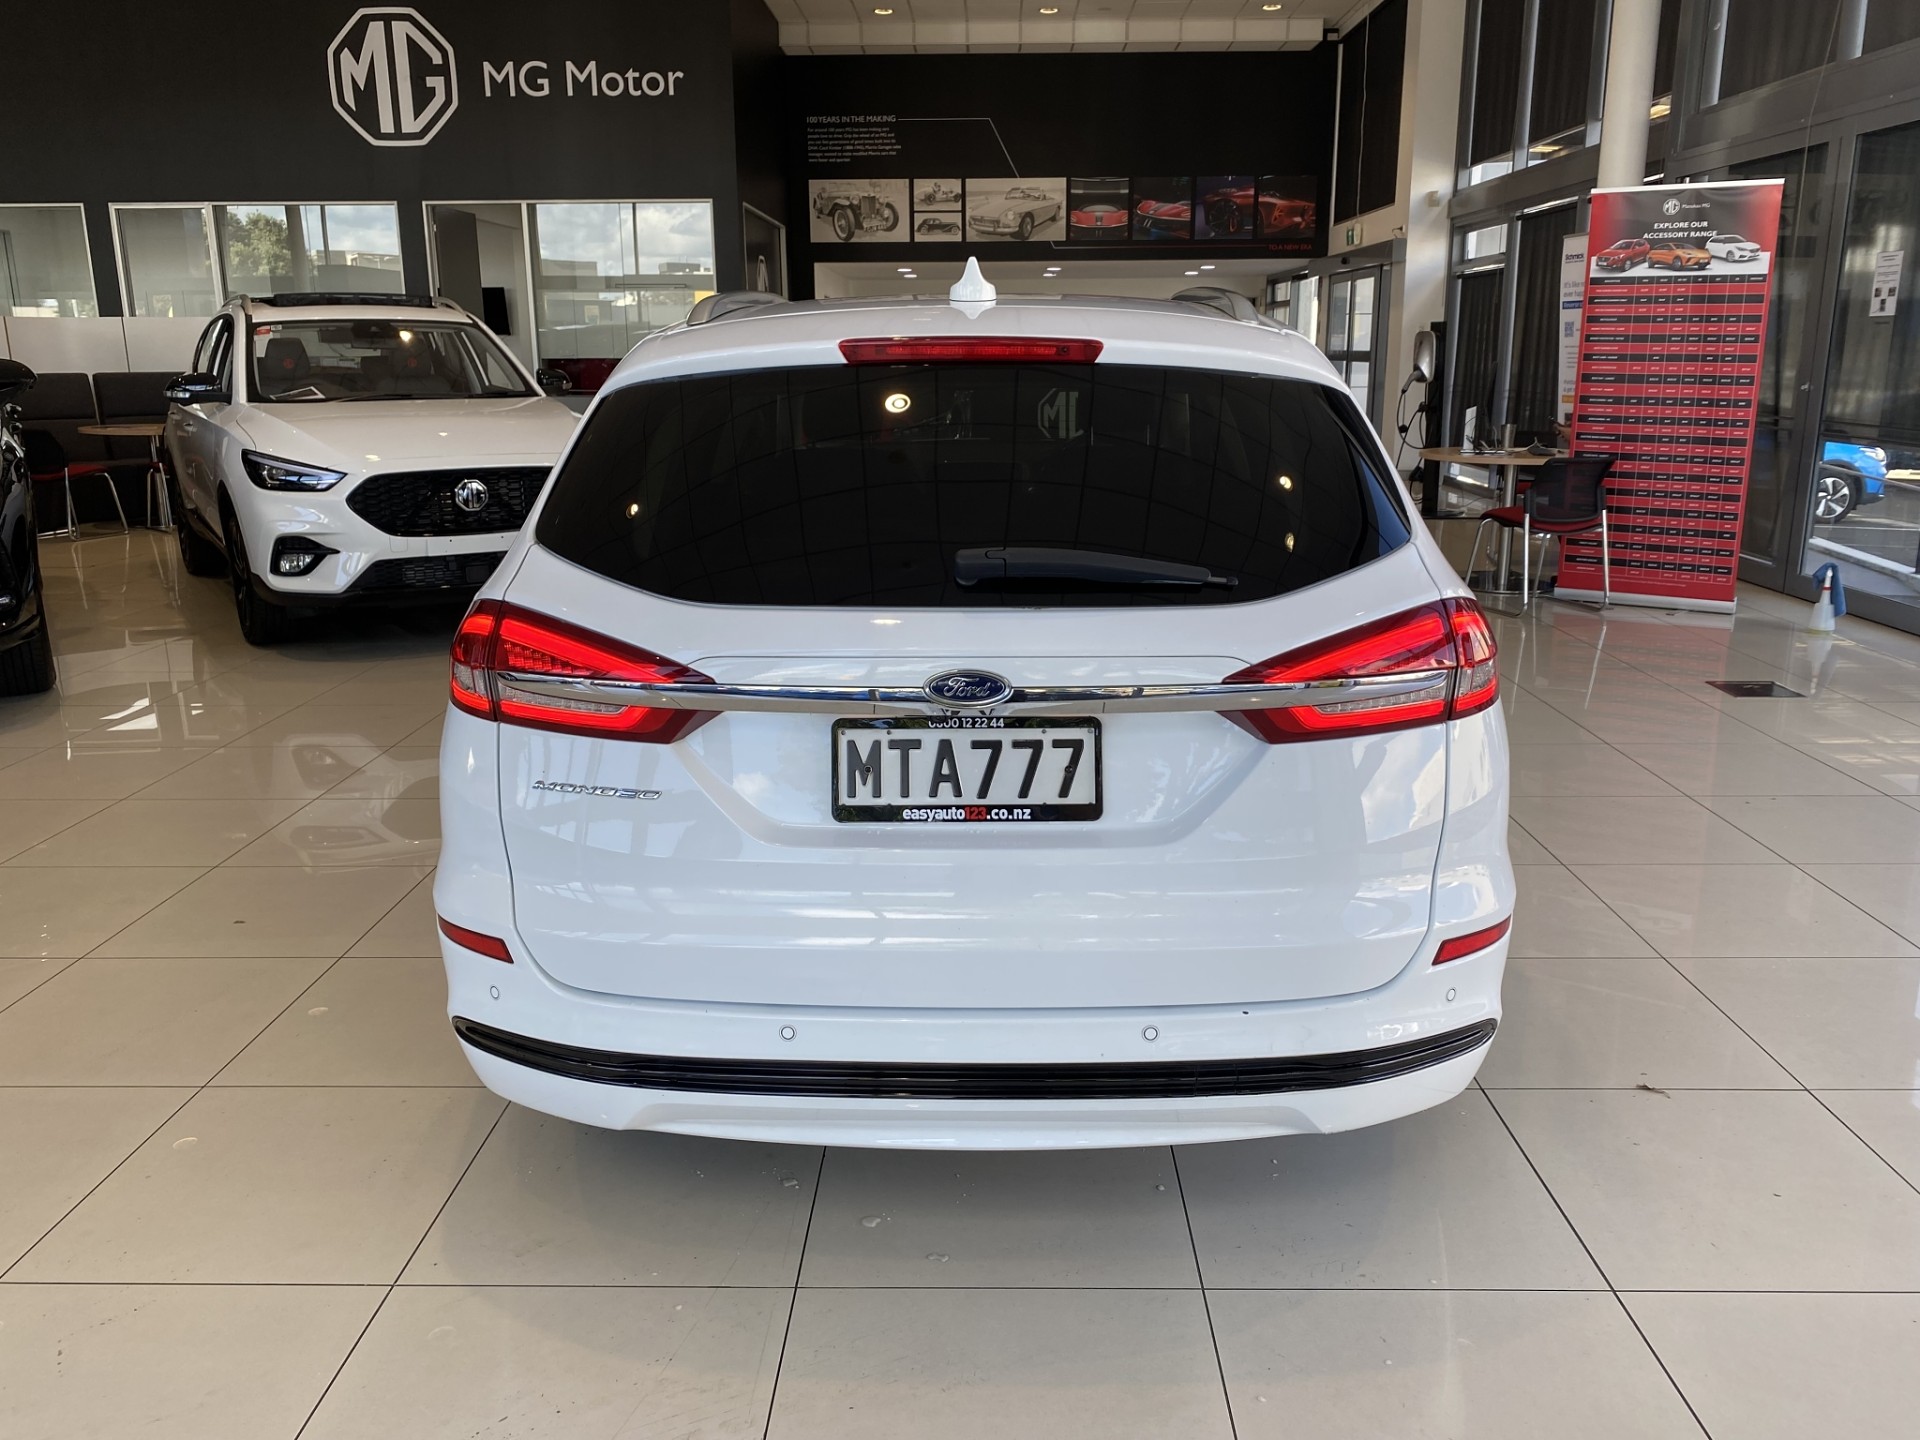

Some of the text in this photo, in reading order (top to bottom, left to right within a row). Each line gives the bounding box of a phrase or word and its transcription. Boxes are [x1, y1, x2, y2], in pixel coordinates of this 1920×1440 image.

[339, 20, 446, 134] MG
[482, 60, 684, 97] MG Motor
[806, 114, 896, 124] 100 YEARS IN THE MAKING
[1664, 199, 1679, 214] MG
[1653, 220, 1709, 230] EXPLORE OUR
[1642, 230, 1718, 239] ACCESSORY RANGE
[458, 482, 485, 509] MG
[943, 676, 992, 697] Ford
[961, 718, 973, 728] 12
[975, 718, 988, 728] 22
[990, 718, 1004, 728] 44
[846, 739, 1085, 799] MTA777
[532, 780, 663, 800] MONDEO
[902, 806, 1031, 822] easyauto123.co.nz
